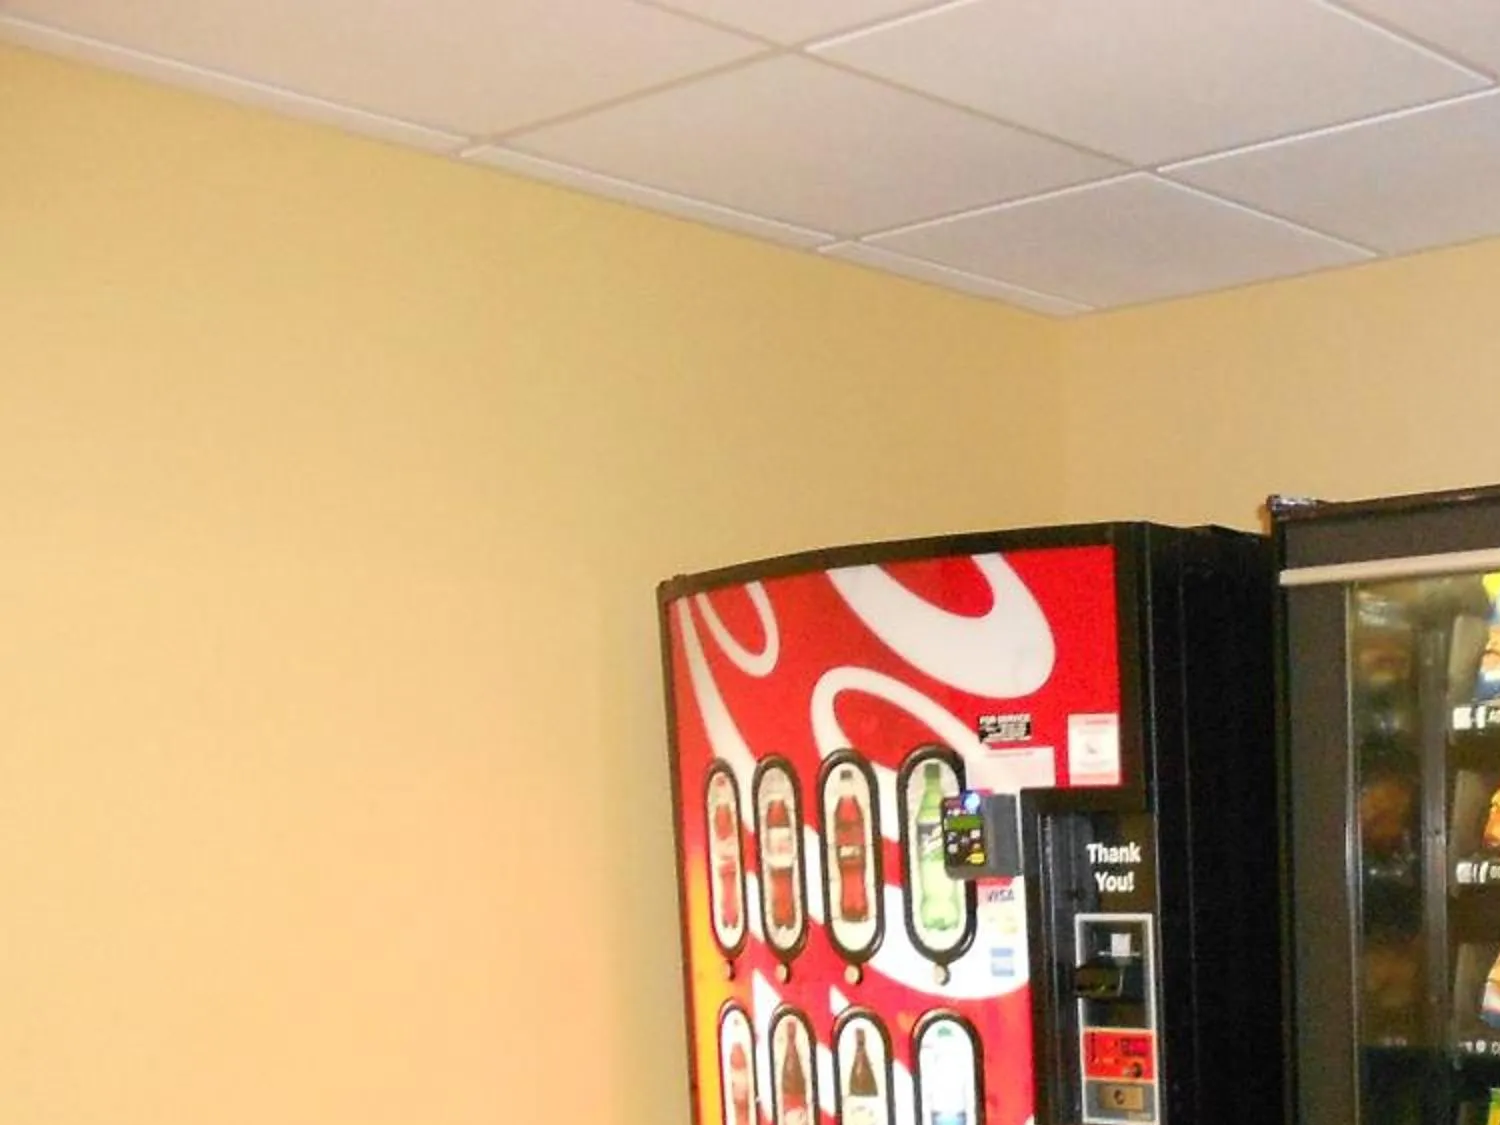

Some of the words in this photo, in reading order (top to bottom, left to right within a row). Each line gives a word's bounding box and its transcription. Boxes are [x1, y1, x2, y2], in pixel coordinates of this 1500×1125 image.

[1085, 841, 1142, 864] Thank
[1093, 870, 1135, 893] You!
[986, 888, 1015, 903] VISA
